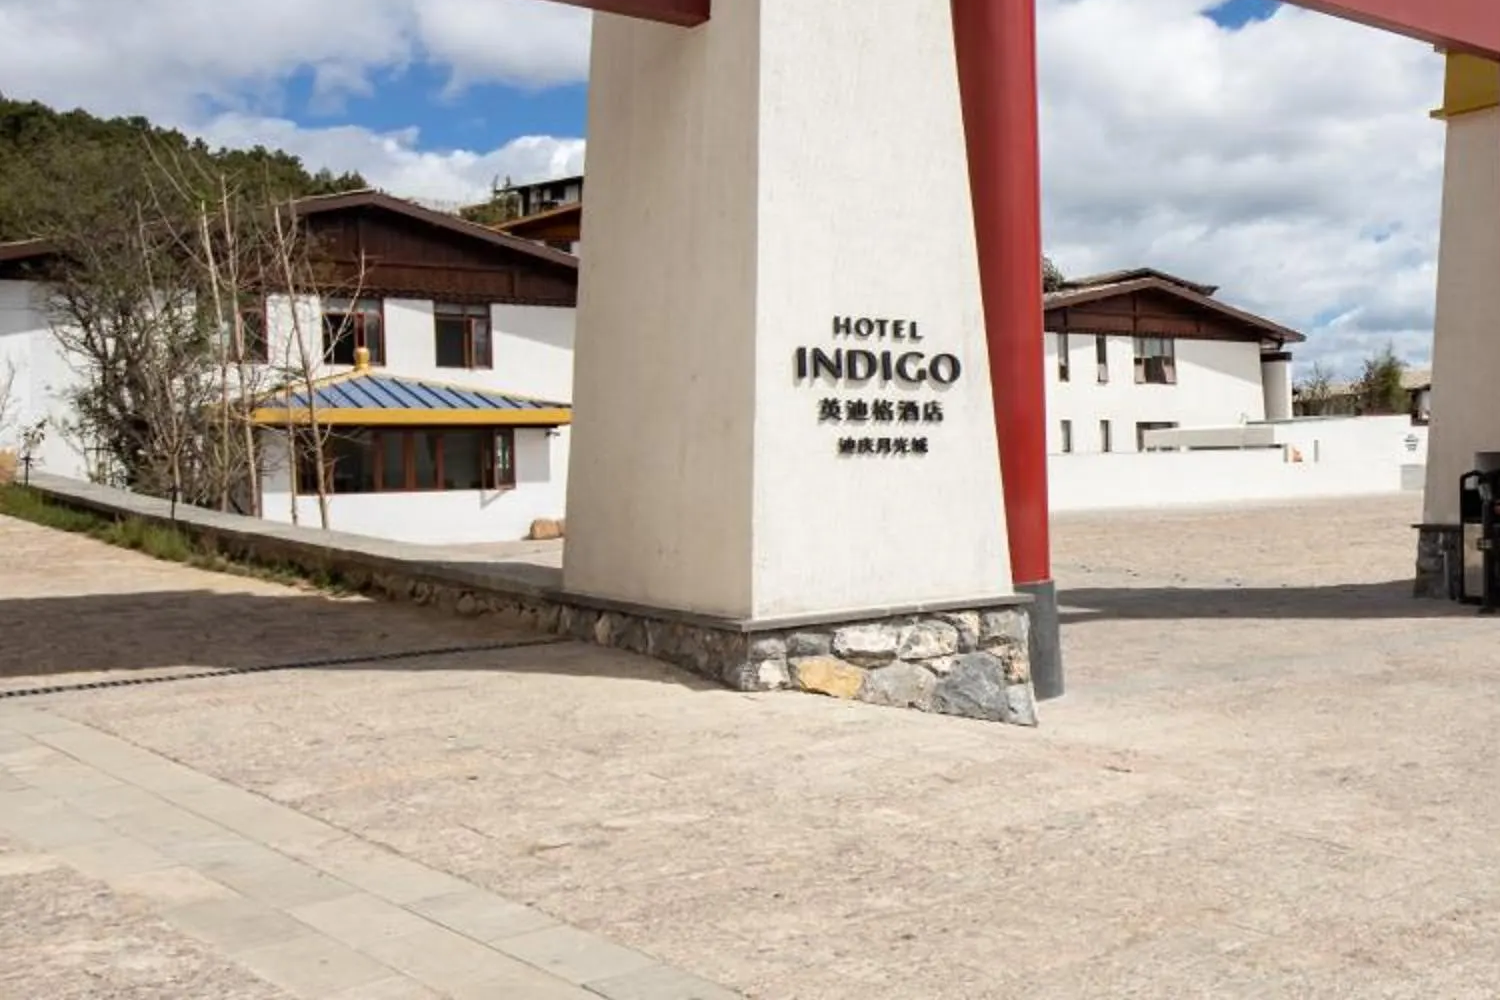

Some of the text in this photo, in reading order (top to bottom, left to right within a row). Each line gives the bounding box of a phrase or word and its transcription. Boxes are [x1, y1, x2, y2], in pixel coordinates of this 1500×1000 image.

[833, 316, 924, 340] HOTEL
[795, 347, 961, 384] INDIGO
[818, 398, 944, 422] 英迪格酒店
[837, 437, 929, 454] 迪庆月光城
